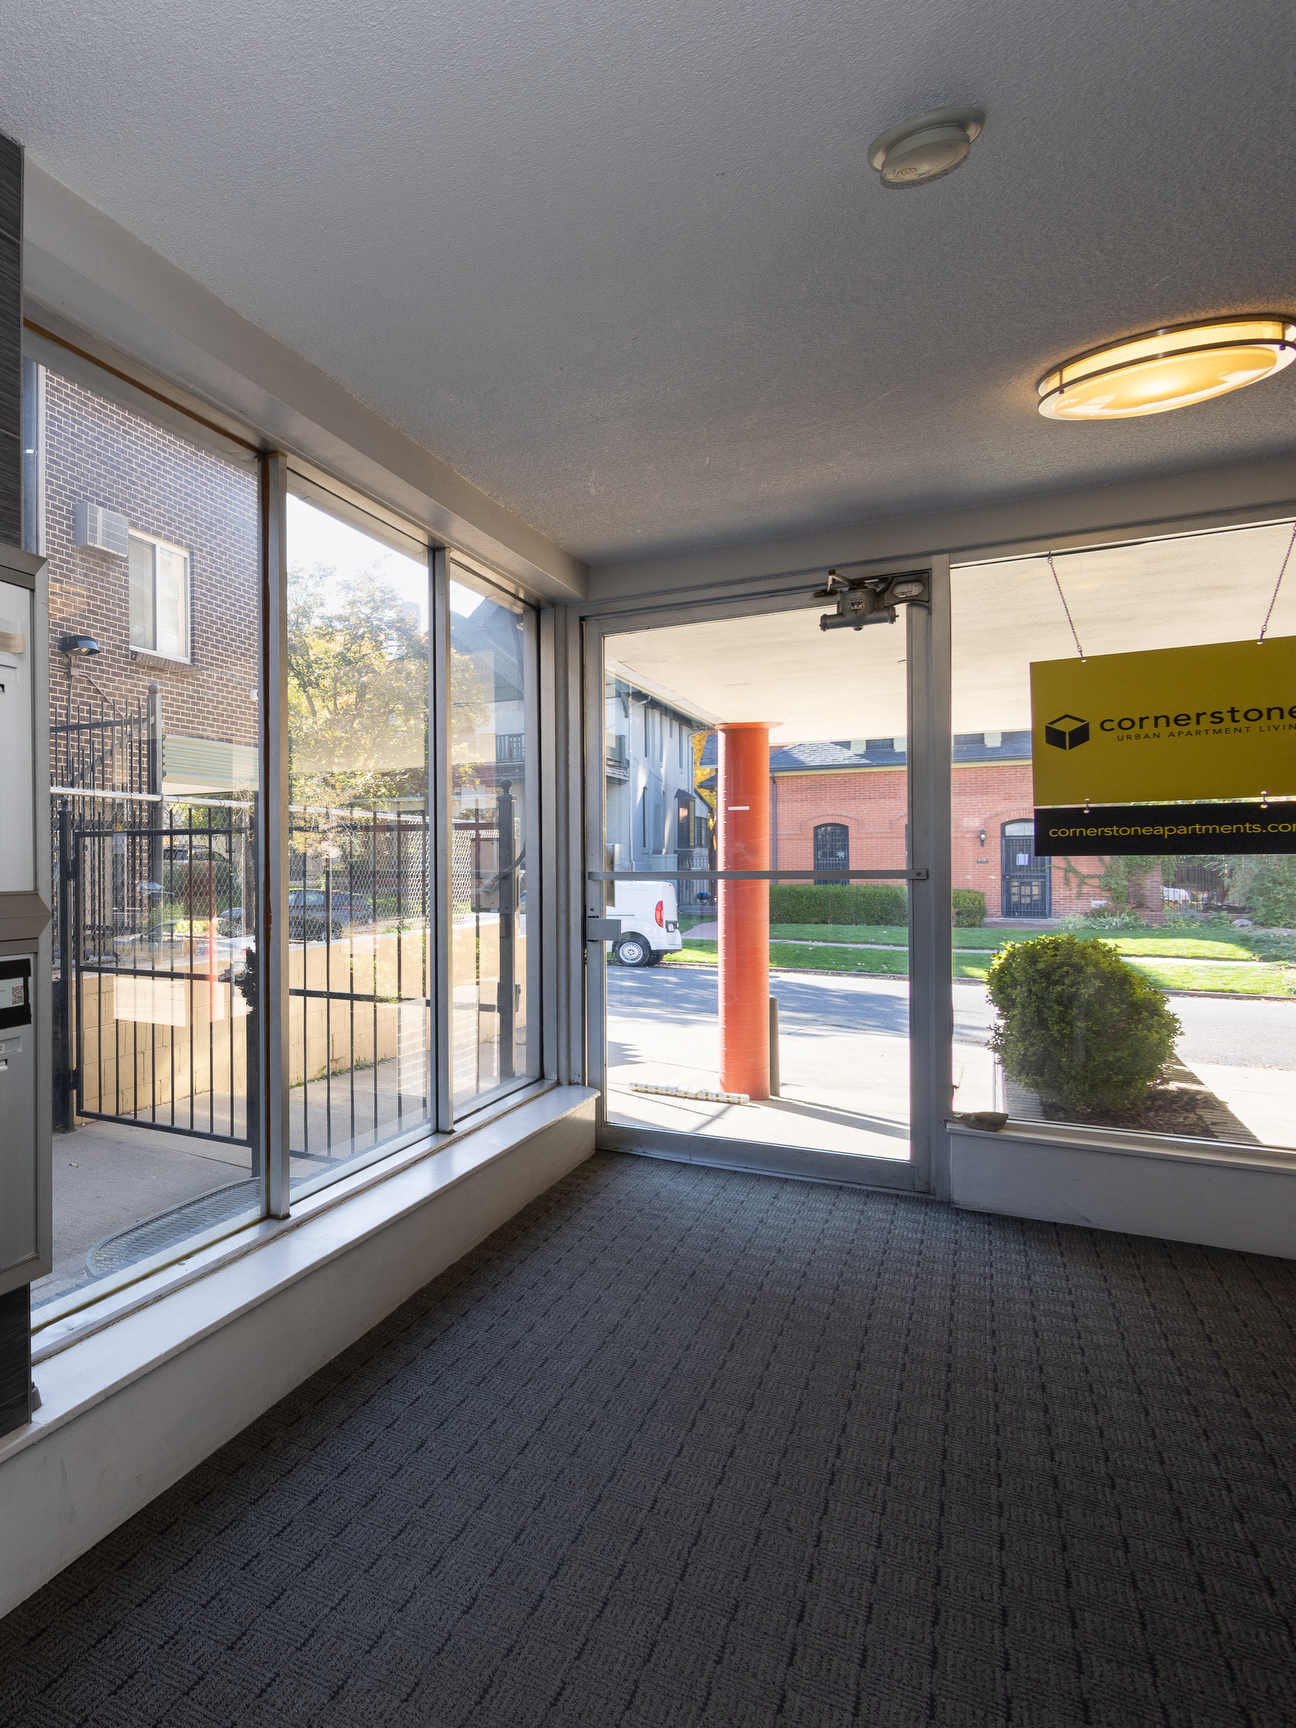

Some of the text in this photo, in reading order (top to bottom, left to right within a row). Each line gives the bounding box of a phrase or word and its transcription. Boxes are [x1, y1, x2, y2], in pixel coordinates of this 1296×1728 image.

[1116, 732, 1162, 743] URBAN
[1167, 726, 1252, 739] APARTMENT
[1048, 822, 1296, 839] cornerstoneapartments.co
